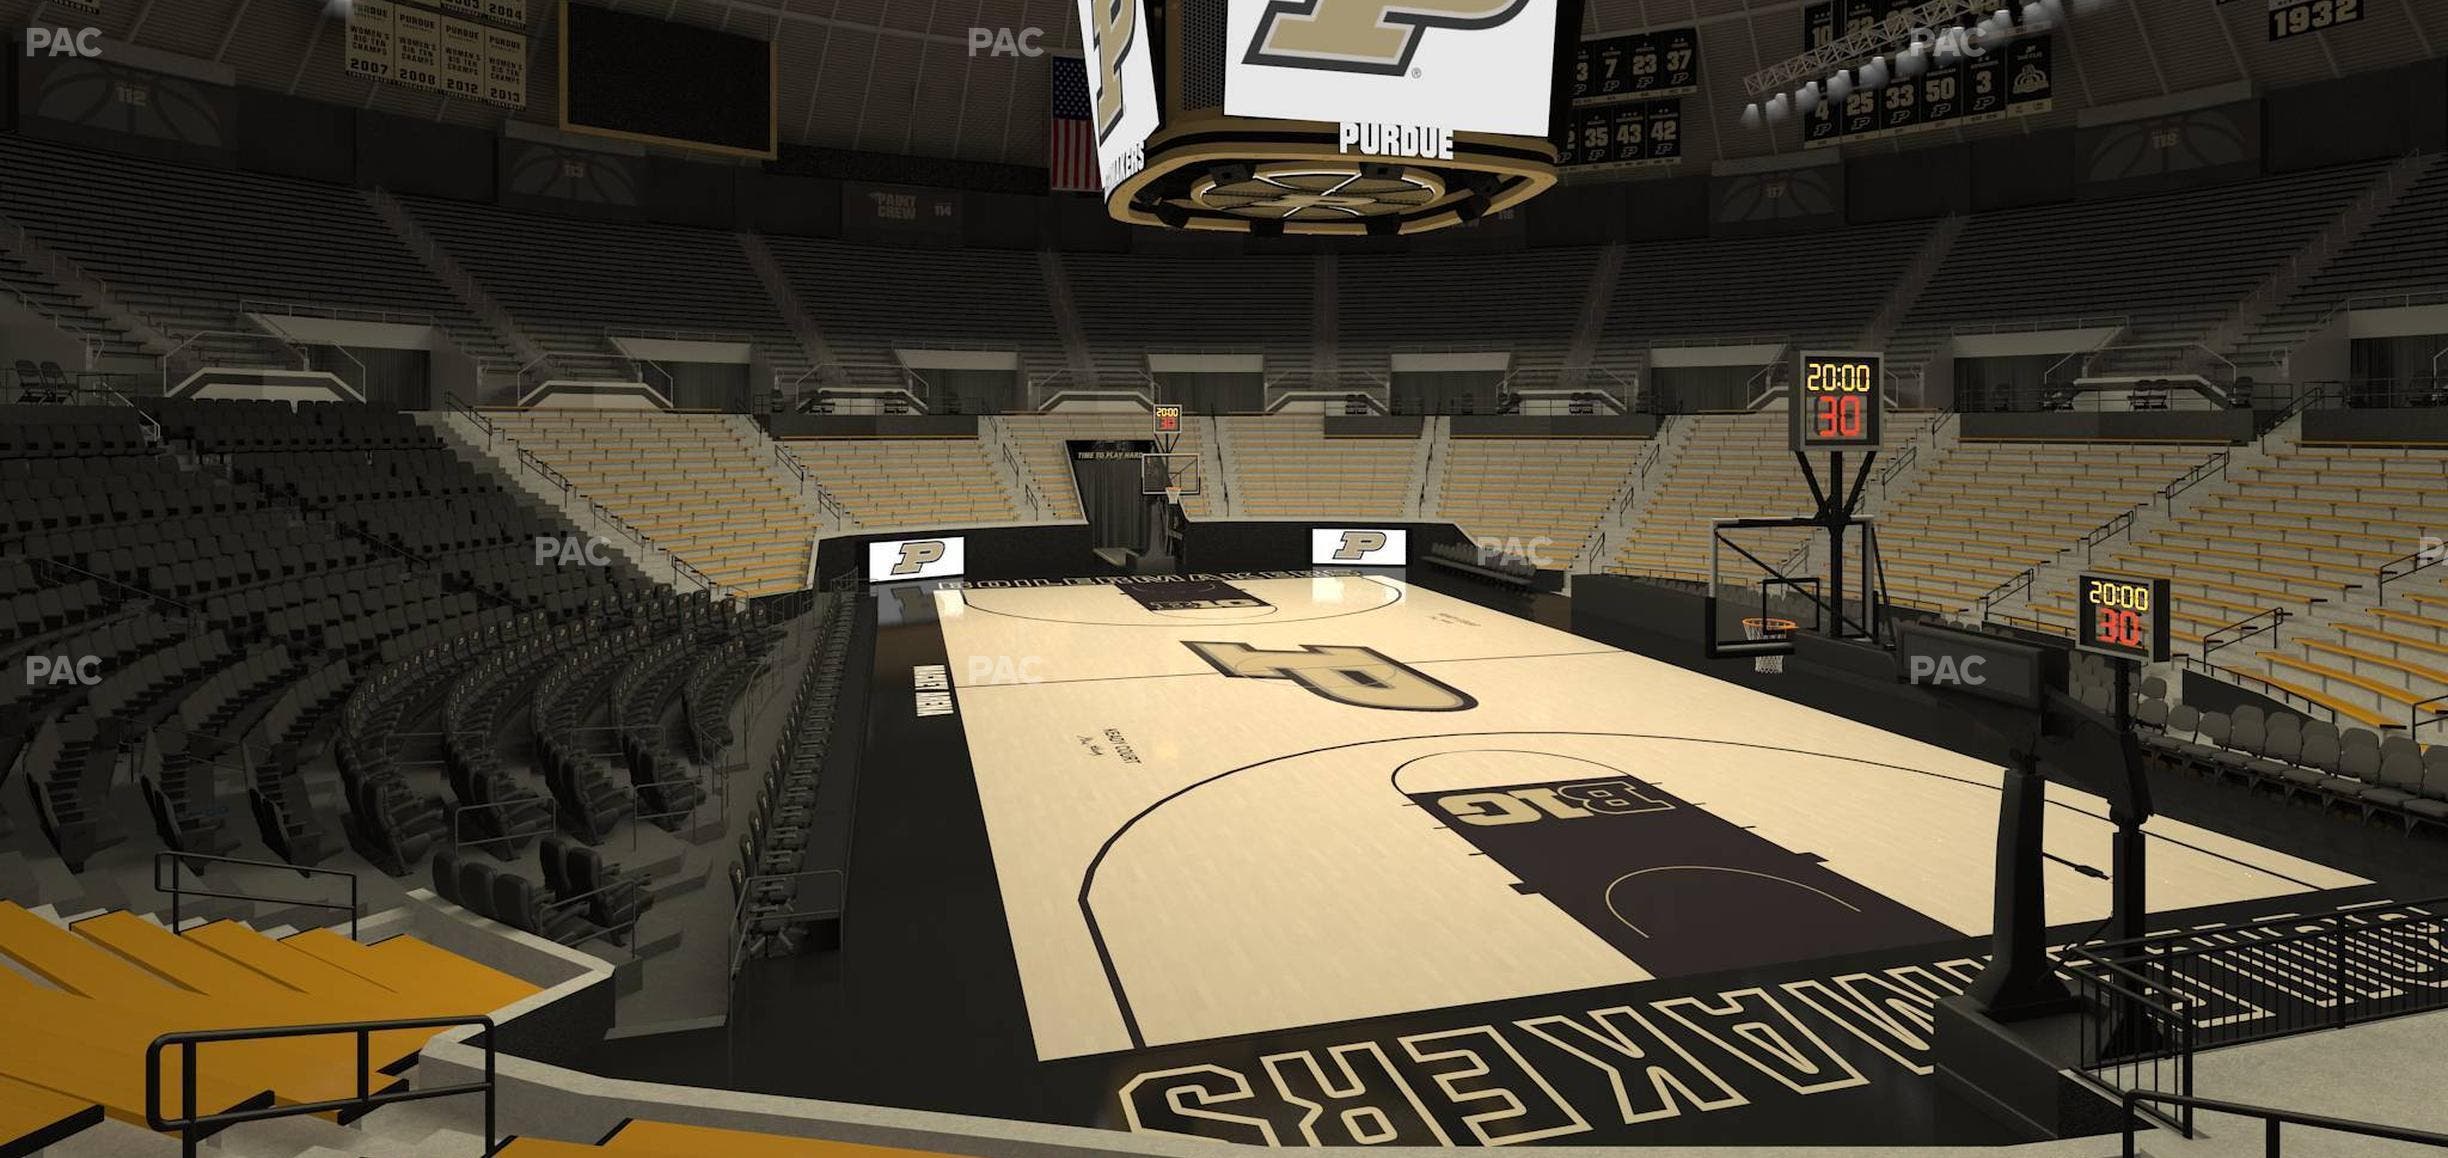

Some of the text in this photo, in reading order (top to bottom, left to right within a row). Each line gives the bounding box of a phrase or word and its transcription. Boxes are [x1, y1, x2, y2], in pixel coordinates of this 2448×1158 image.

[399, 14, 436, 29] PURDUE
[489, 3, 522, 20] 2004
[2274, 0, 2358, 38] 1932
[446, 25, 480, 39] PURDUE
[489, 35, 521, 49] PURDUE
[350, 58, 388, 74] 2007
[1604, 58, 1618, 79] 7
[1632, 54, 1657, 75] 23
[1666, 49, 1693, 71] 37
[399, 68, 436, 85] 2008
[1575, 62, 1589, 81] 3
[447, 78, 478, 94] 2012
[1925, 77, 1956, 102] 50
[1975, 71, 1993, 94] 3
[1846, 91, 1874, 115] 25
[1885, 85, 1914, 110] 33
[1340, 121, 1454, 160] PURDUE
[1584, 127, 1608, 148] 35
[1616, 123, 1642, 144] 43
[1650, 120, 1677, 141] 42
[1807, 363, 1870, 392] 20:00
[1156, 407, 1179, 417] 20:00
[1818, 395, 1861, 437] 30
[1078, 451, 1095, 459] TIME
[1105, 451, 1123, 459] PLAY
[1334, 531, 1387, 560] P
[890, 541, 945, 575] P
[2090, 581, 2149, 611] 20:00
[2097, 607, 2140, 646] 30
